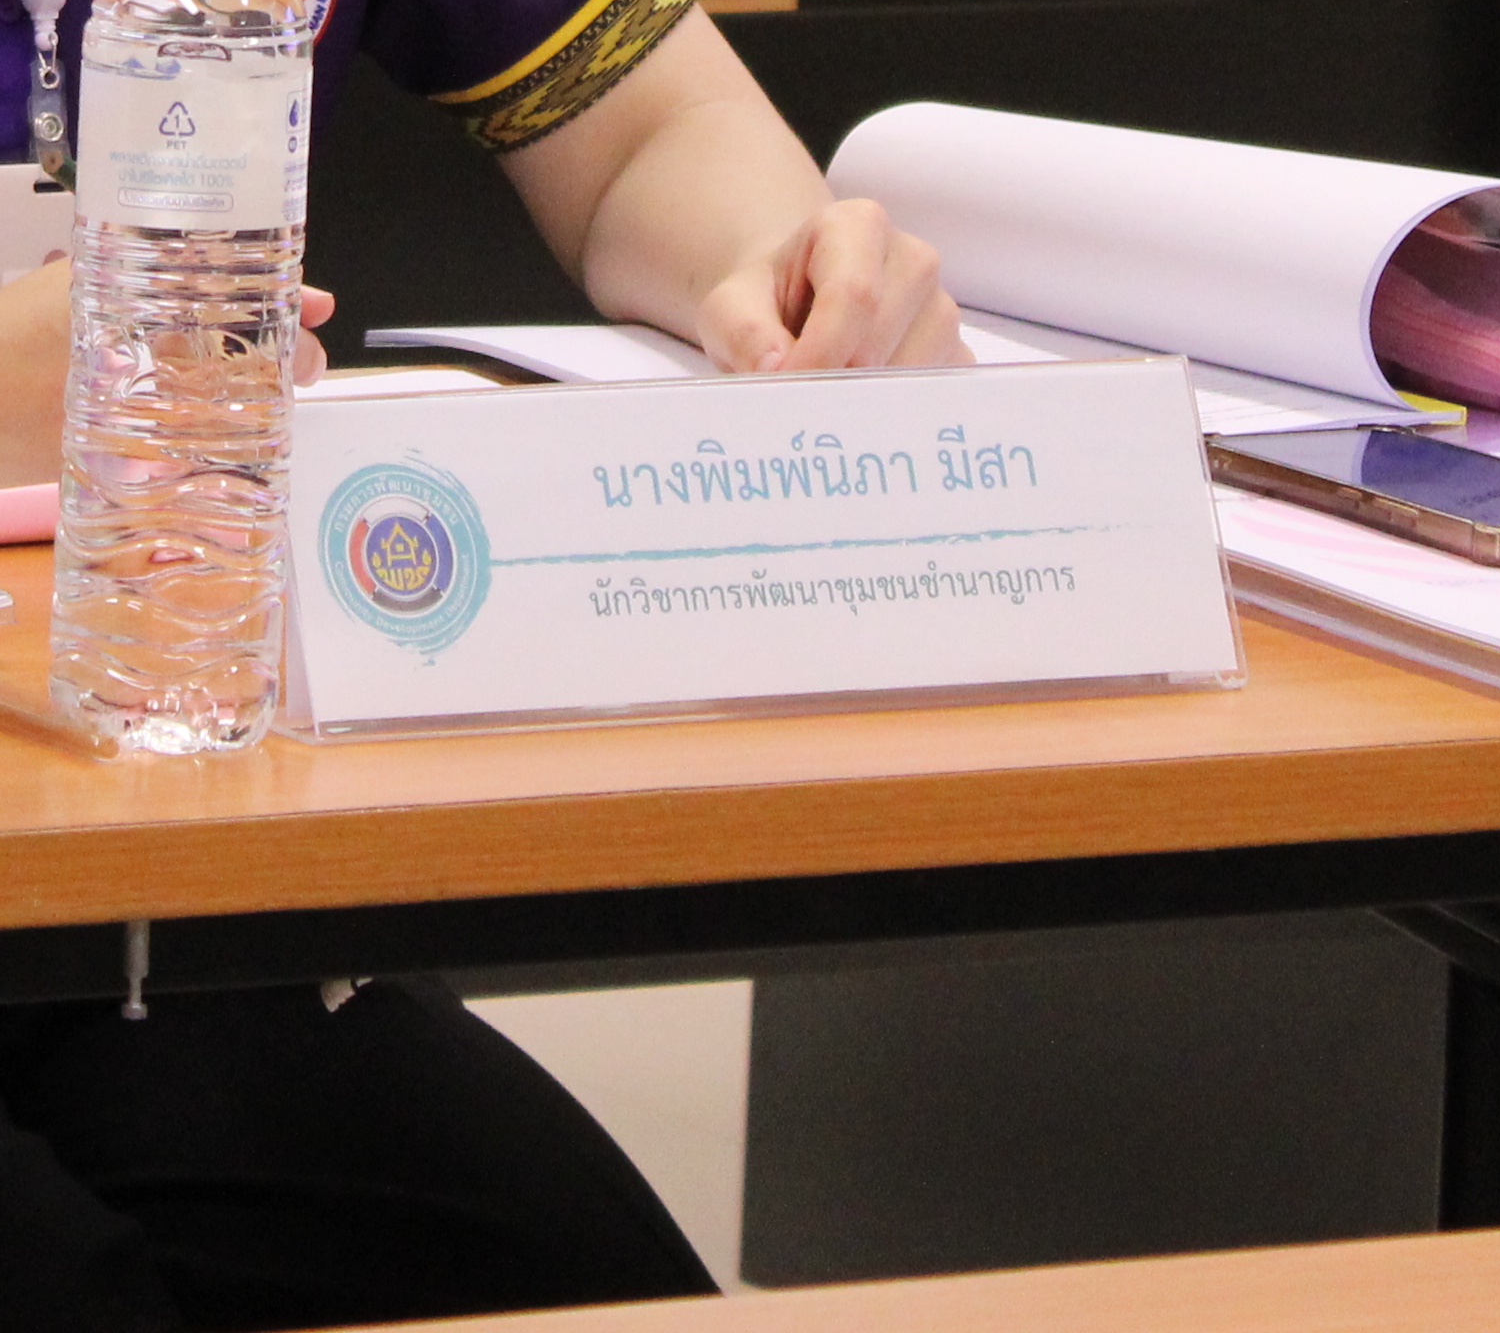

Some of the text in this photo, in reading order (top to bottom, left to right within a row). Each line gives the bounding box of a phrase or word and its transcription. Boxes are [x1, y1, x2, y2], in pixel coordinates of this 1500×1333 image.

[166, 140, 188, 150] PET
[200, 172, 236, 189] 100%
[594, 425, 1039, 509] นางพิมพ์นิภา มีสา
[334, 475, 460, 533] กรมการพัฒนาชุมชน
[588, 560, 1077, 618] นักวิชาการพัฒนาชุมชนชำนาญการ
[376, 615, 446, 636] Development
